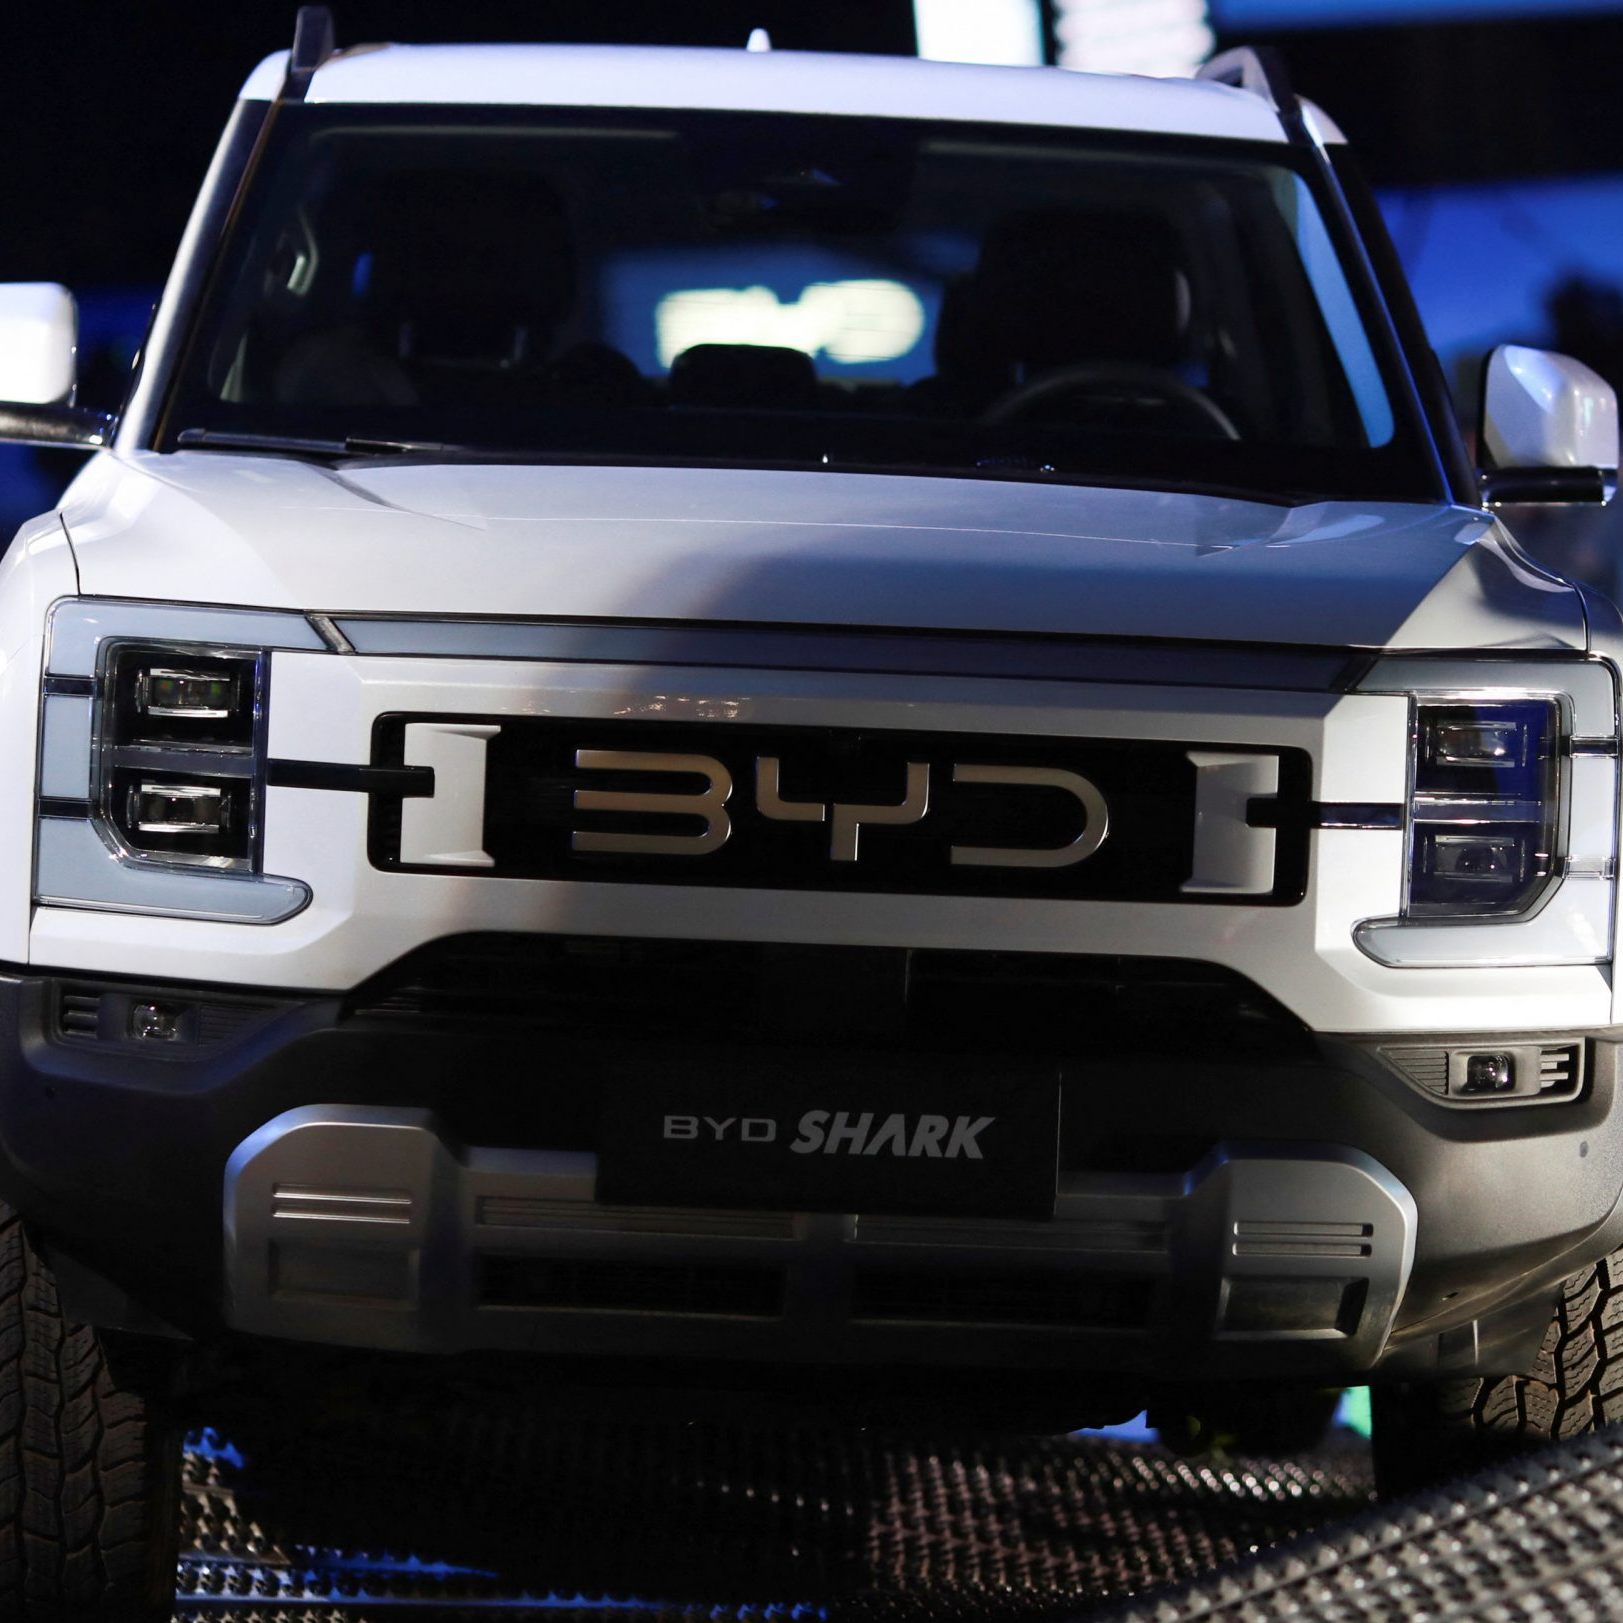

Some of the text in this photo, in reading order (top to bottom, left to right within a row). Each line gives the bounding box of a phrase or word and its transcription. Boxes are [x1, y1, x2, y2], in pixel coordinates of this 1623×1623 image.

[572, 749, 1110, 867] BYD
[664, 1110, 996, 1159] BYD SHARK
